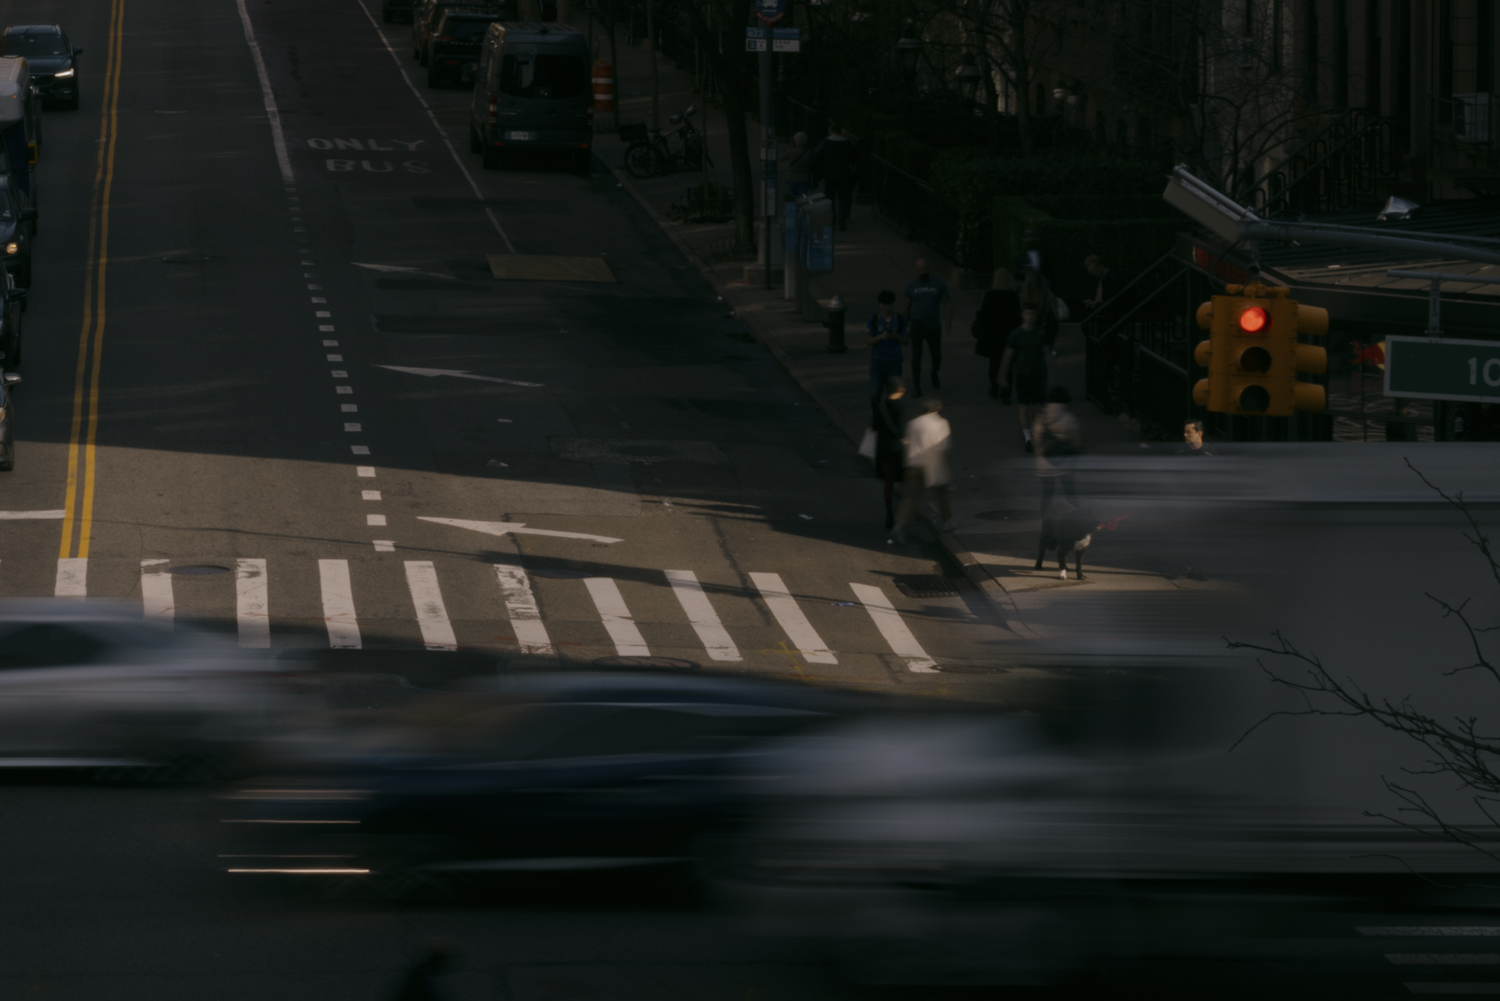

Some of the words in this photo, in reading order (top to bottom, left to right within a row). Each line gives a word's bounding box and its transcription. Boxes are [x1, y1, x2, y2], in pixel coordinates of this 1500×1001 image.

[307, 138, 425, 152] ONLY
[326, 159, 432, 174] BUS
[1467, 357, 1500, 387] 10
